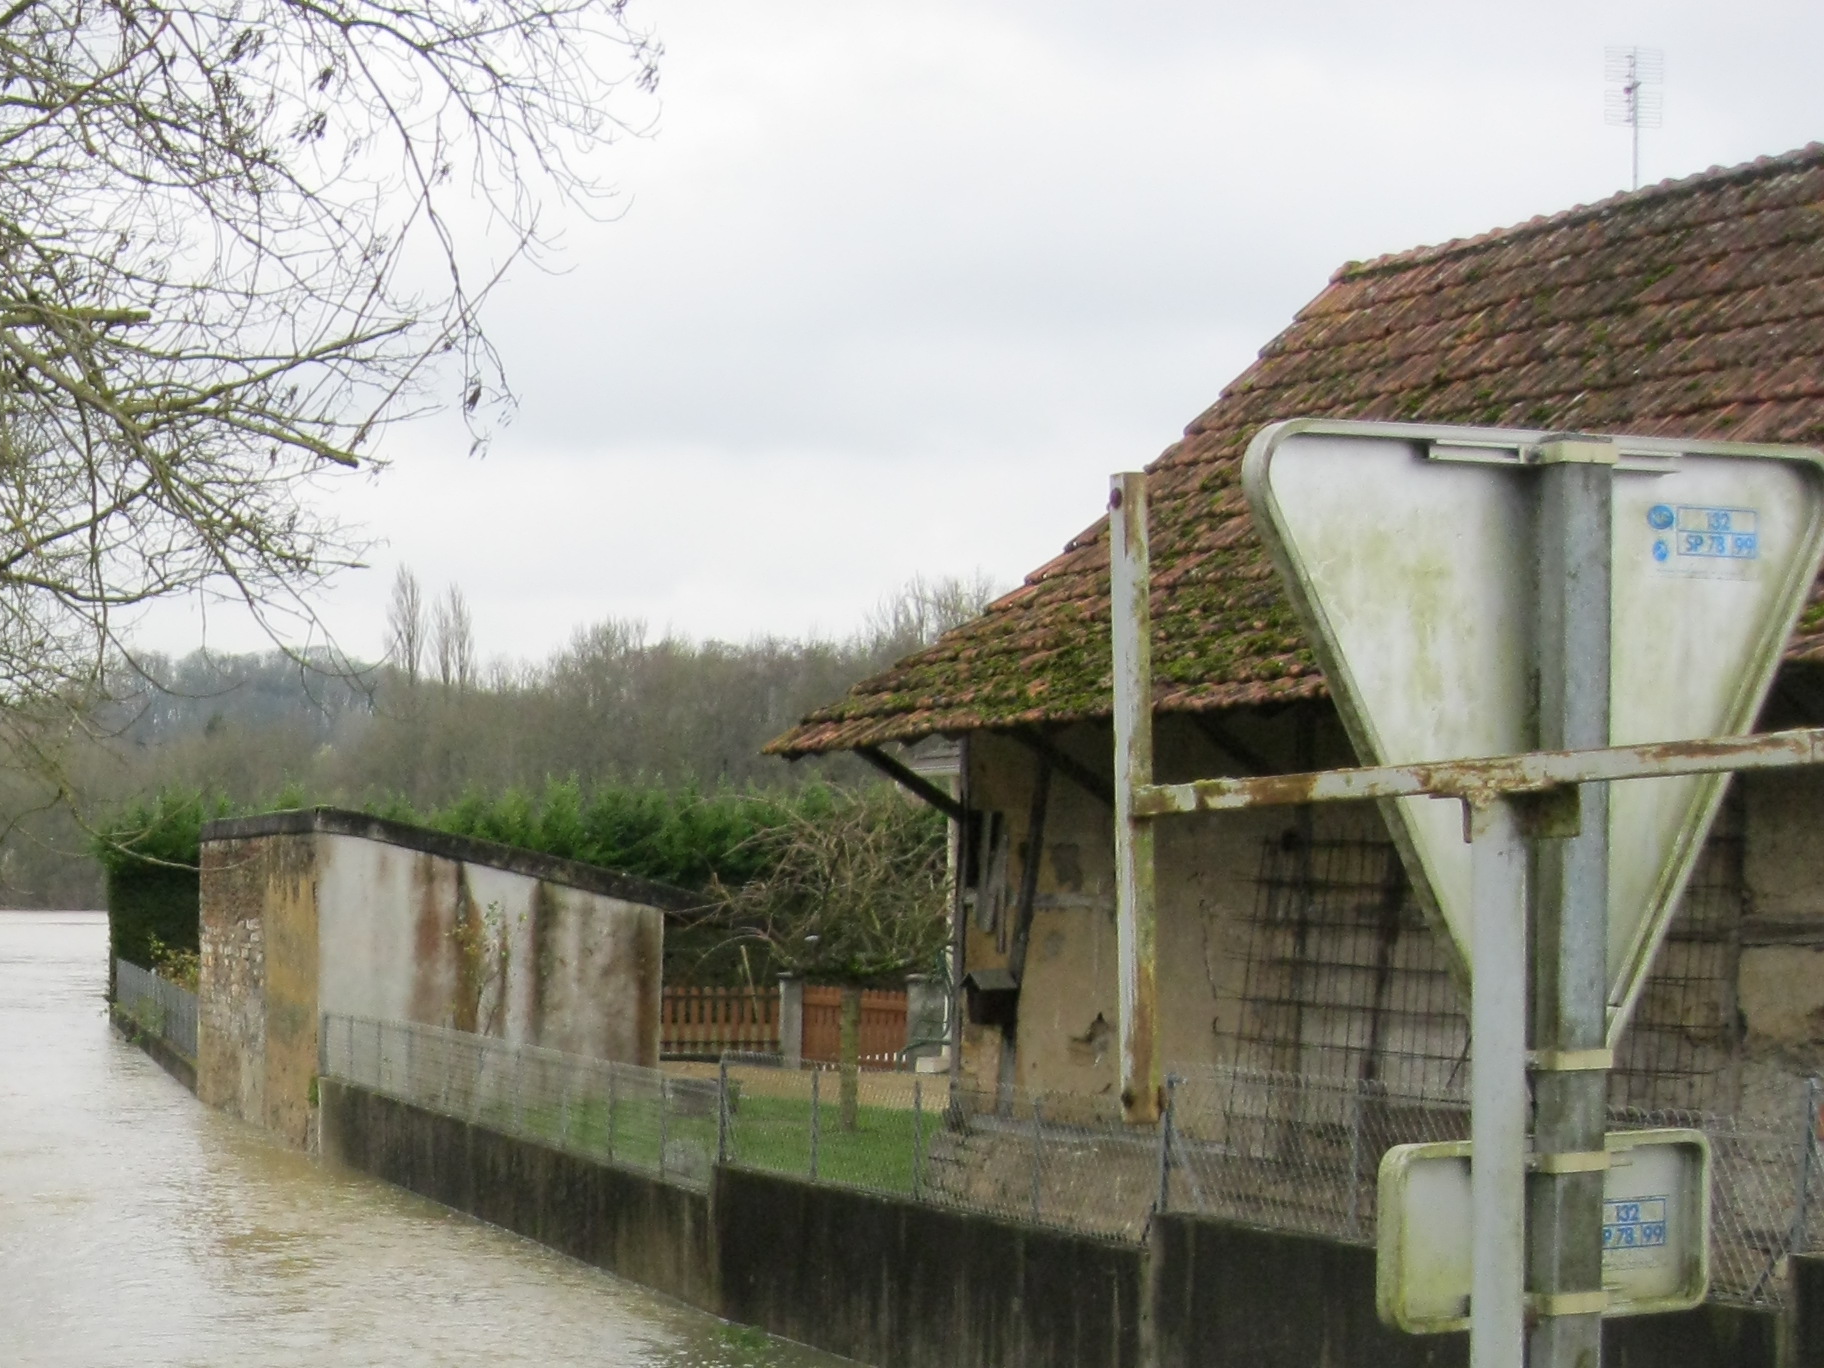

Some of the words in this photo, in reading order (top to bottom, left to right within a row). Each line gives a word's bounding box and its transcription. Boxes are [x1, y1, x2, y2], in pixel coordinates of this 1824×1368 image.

[1686, 535, 1703, 552] SP
[1735, 536, 1755, 556] 99
[1616, 1204, 1639, 1222] 132
[1603, 1228, 1612, 1245] P
[1616, 1227, 1634, 1245] 78
[1643, 1225, 1662, 1243] 99
